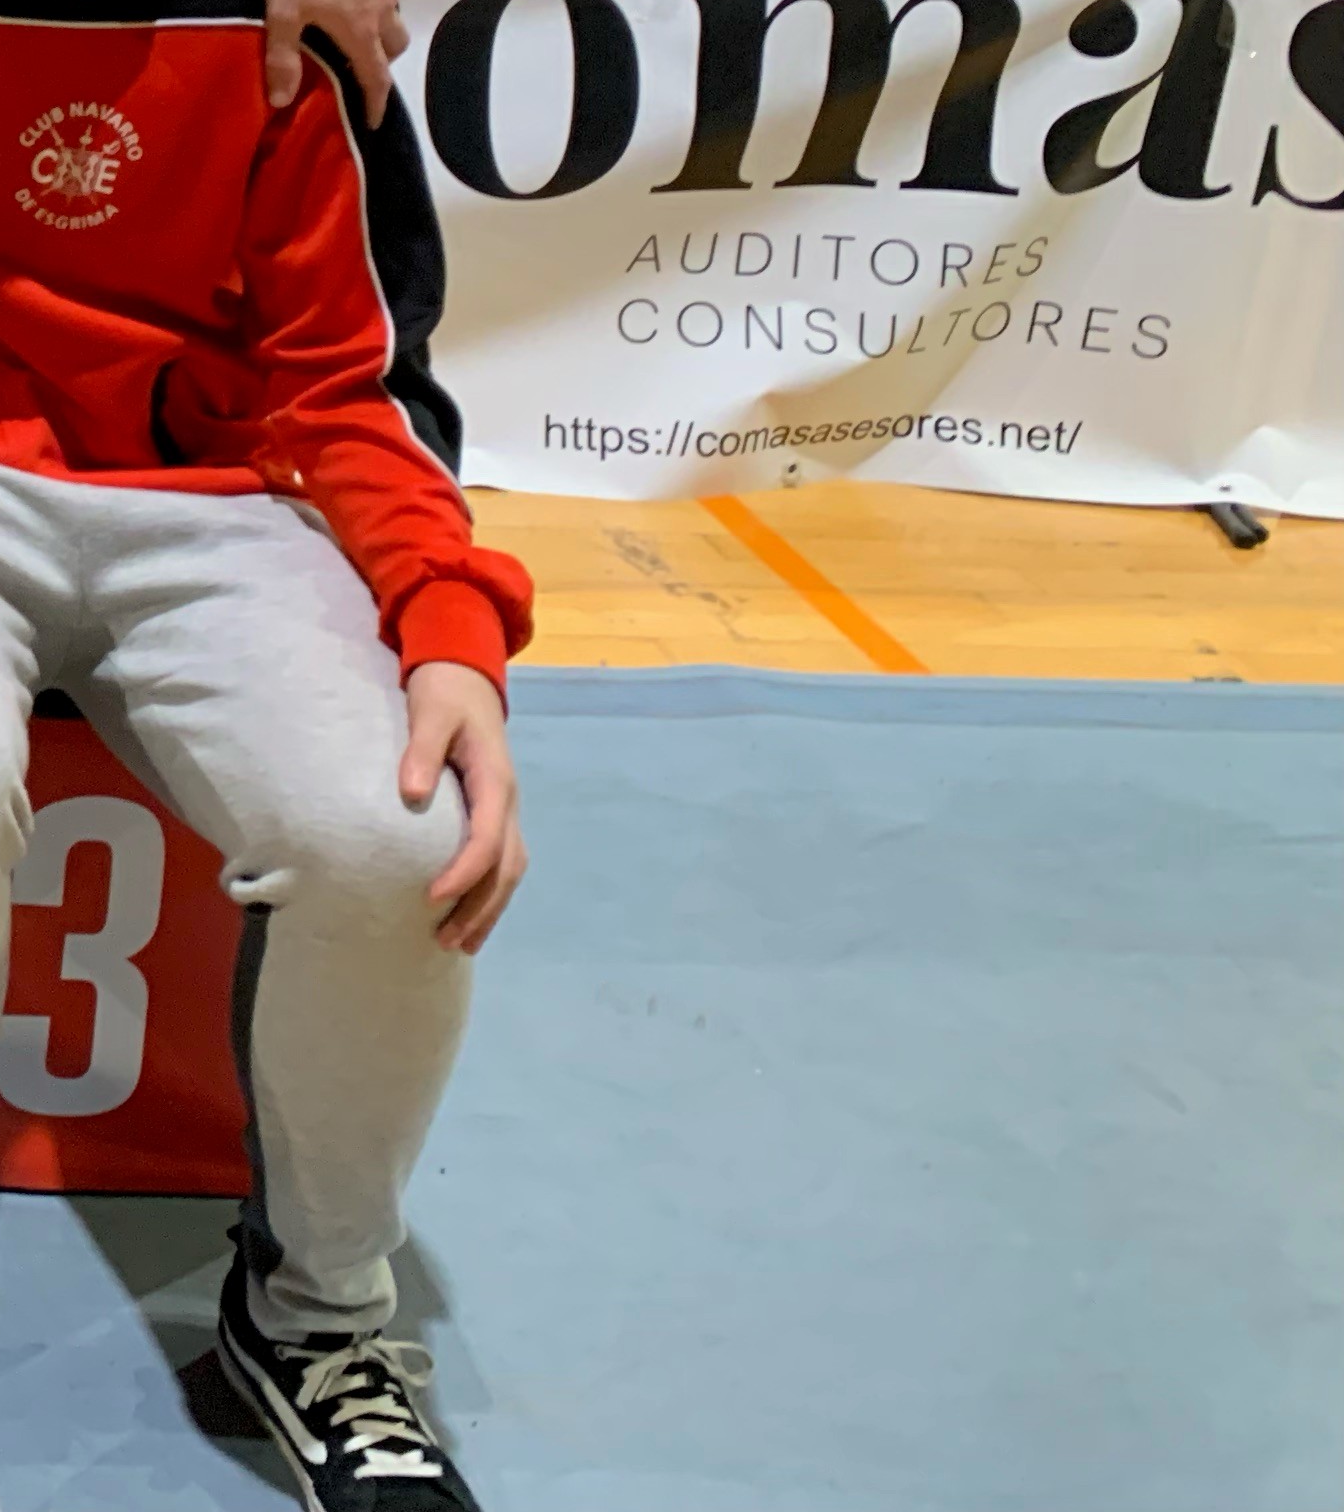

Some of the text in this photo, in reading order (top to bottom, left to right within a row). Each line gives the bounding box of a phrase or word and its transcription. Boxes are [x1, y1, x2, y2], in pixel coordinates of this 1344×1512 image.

[19, 101, 143, 161] CLUB NAVARRO
[15, 188, 119, 230] DE ESGRIMA
[625, 231, 1050, 289] AUDITORES
[617, 297, 1172, 361] CONSULTORES
[544, 411, 1085, 462] https://comasasesores.net/
